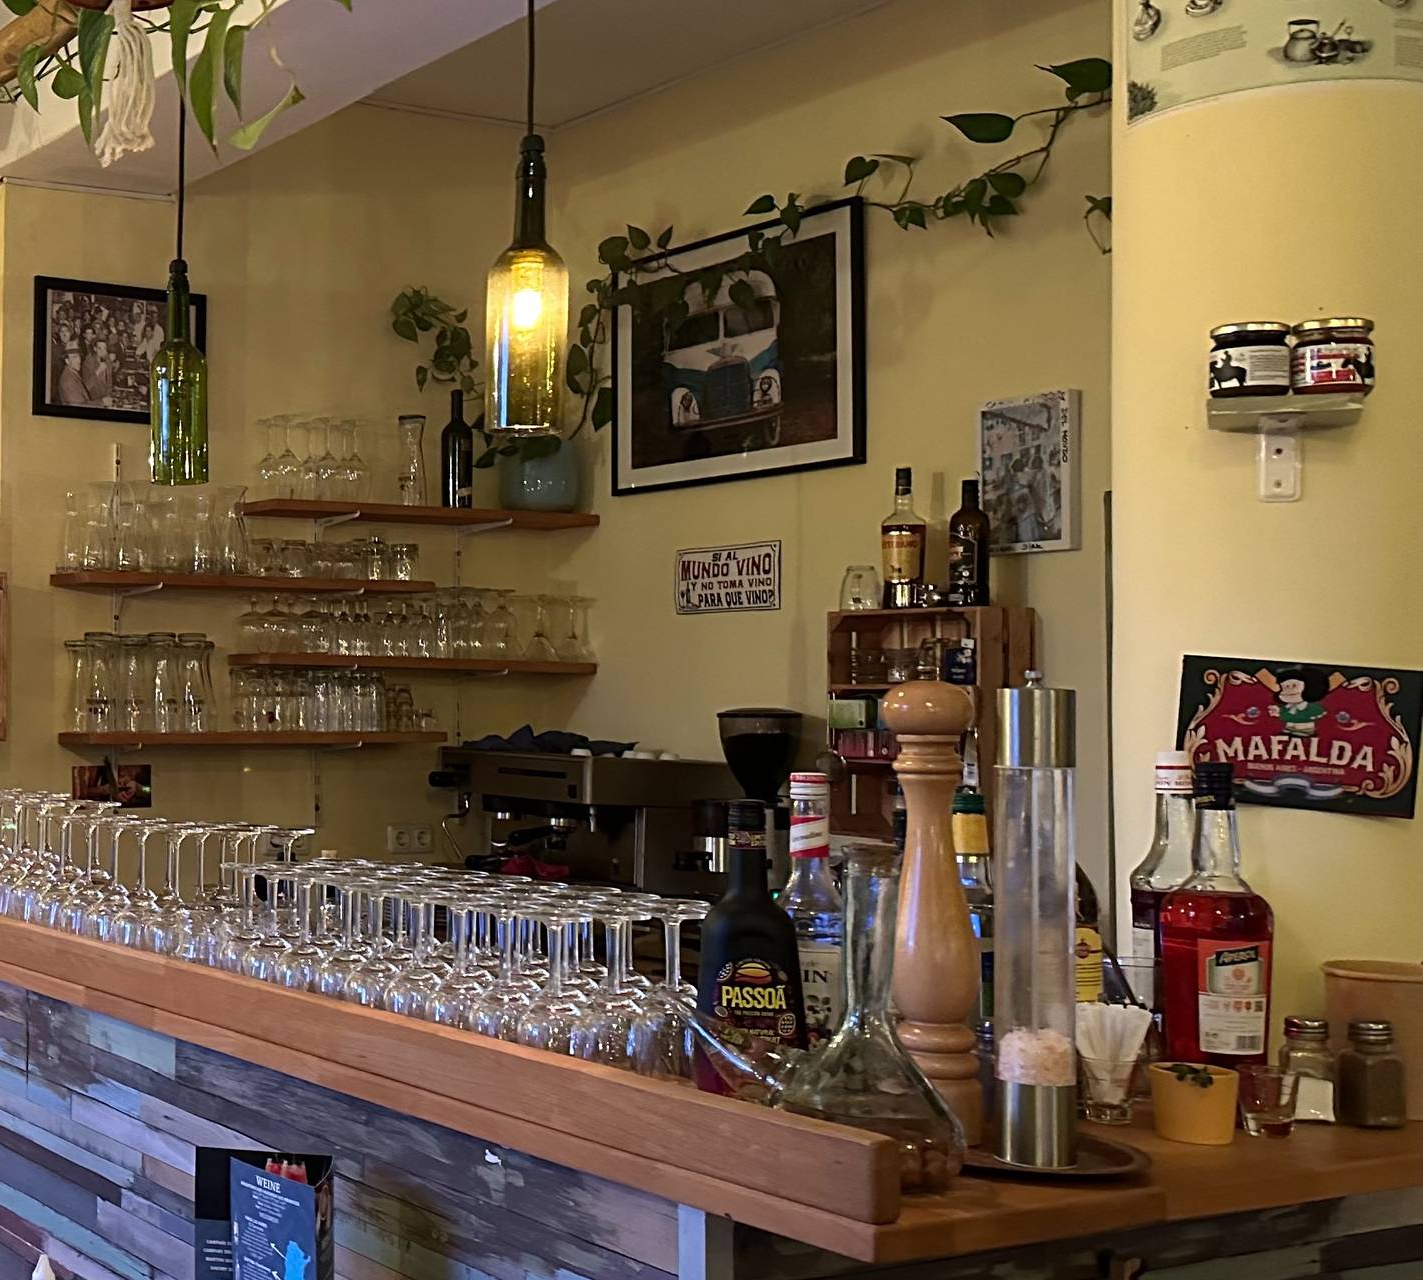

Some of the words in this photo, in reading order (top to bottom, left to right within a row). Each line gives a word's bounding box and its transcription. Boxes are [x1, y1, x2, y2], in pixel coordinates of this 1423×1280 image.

[712, 552, 722, 562] SI
[725, 551, 738, 561] AL
[681, 560, 729, 581] MUNDO
[737, 553, 772, 576] VINO
[701, 581, 714, 591] NO
[717, 579, 744, 590] TOMA
[748, 577, 772, 588] VINO
[698, 592, 723, 607] PARA
[725, 591, 743, 608] QUE
[745, 589, 775, 605] VINO?
[1215, 735, 1374, 772] MAFALDA
[802, 969, 829, 983] IN
[721, 985, 787, 1010] PASSOÃ
[255, 1175, 281, 1193] WEINE
